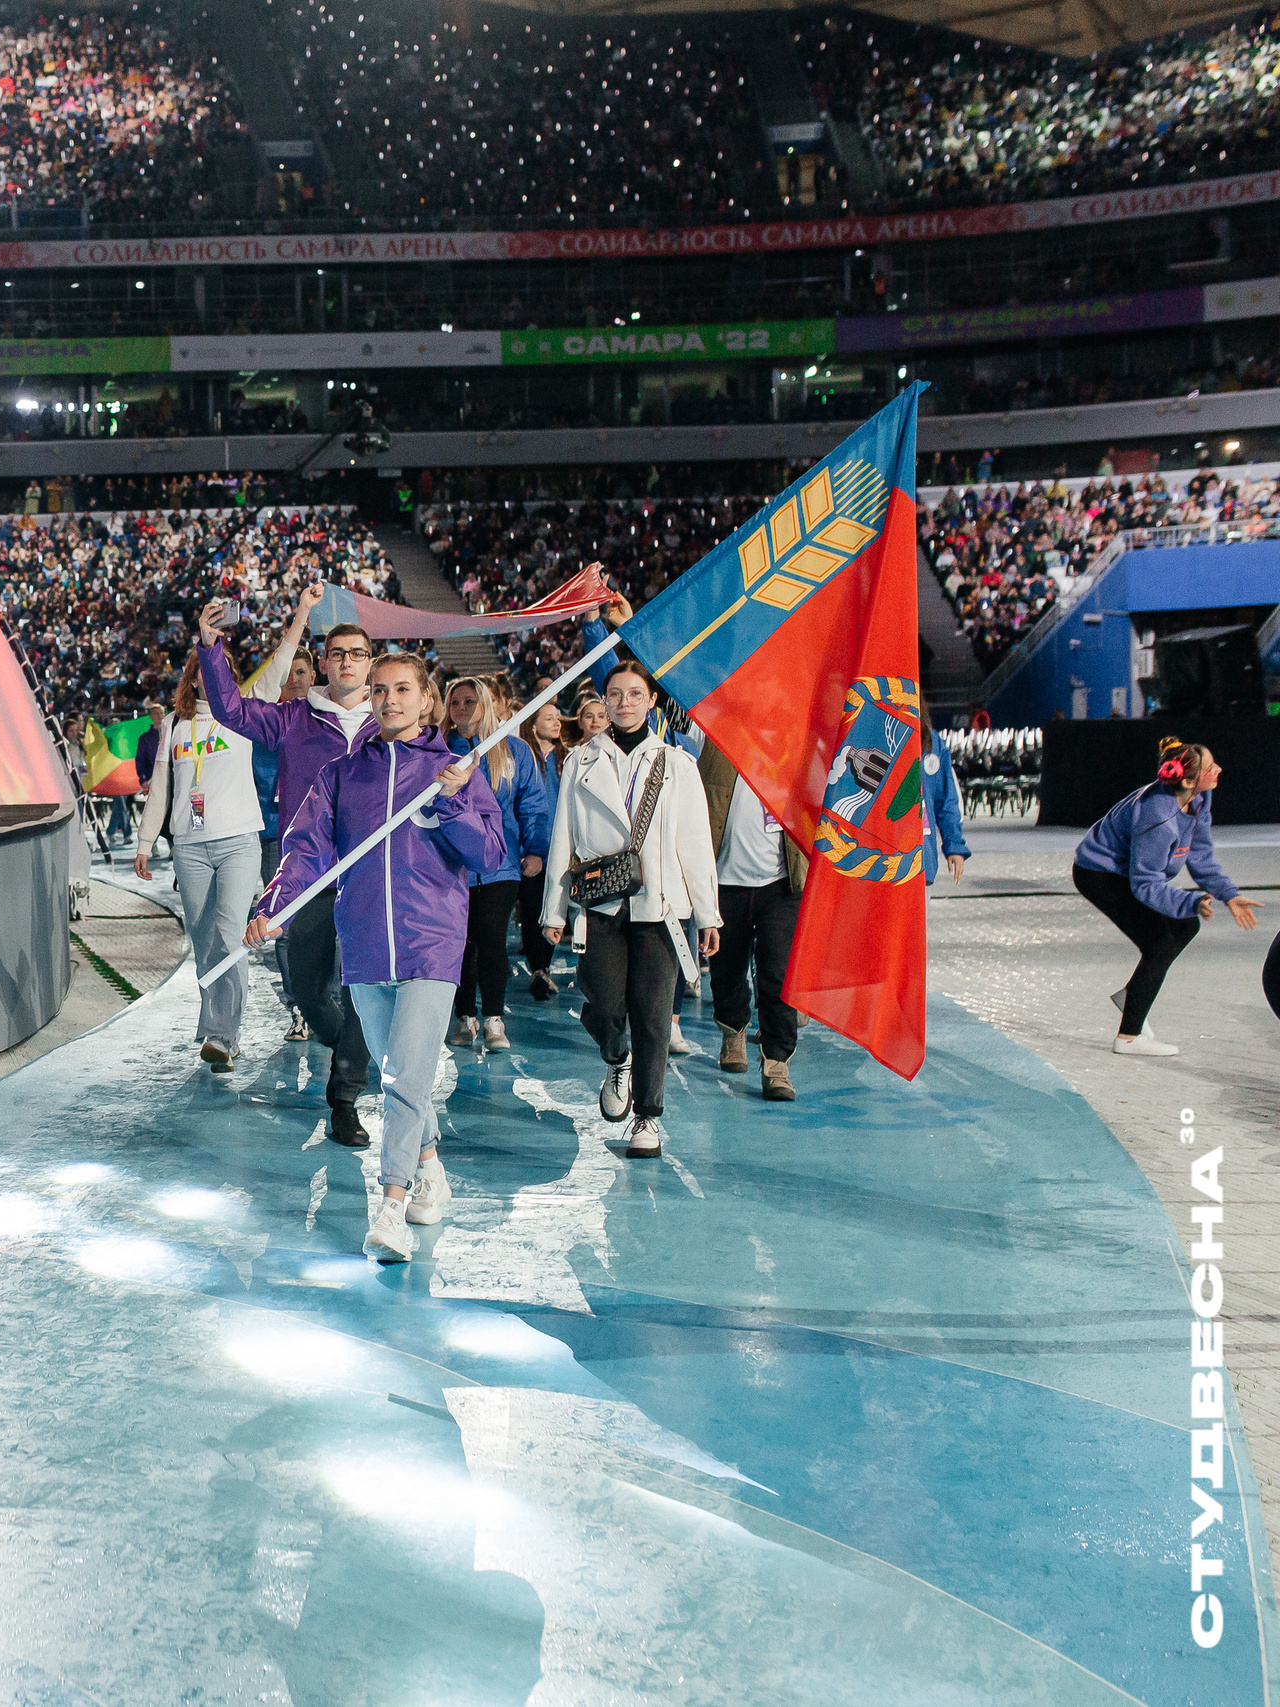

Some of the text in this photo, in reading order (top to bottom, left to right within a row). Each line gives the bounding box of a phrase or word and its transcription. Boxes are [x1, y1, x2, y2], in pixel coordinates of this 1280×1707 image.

[559, 214, 956, 254] СОЛИДАРНОСТЬ САМАРА АРЕНА
[73, 236, 457, 263] СОЛИДАРНОСТЬ САМАРА АРЕНА
[563, 331, 706, 355] САМАРА
